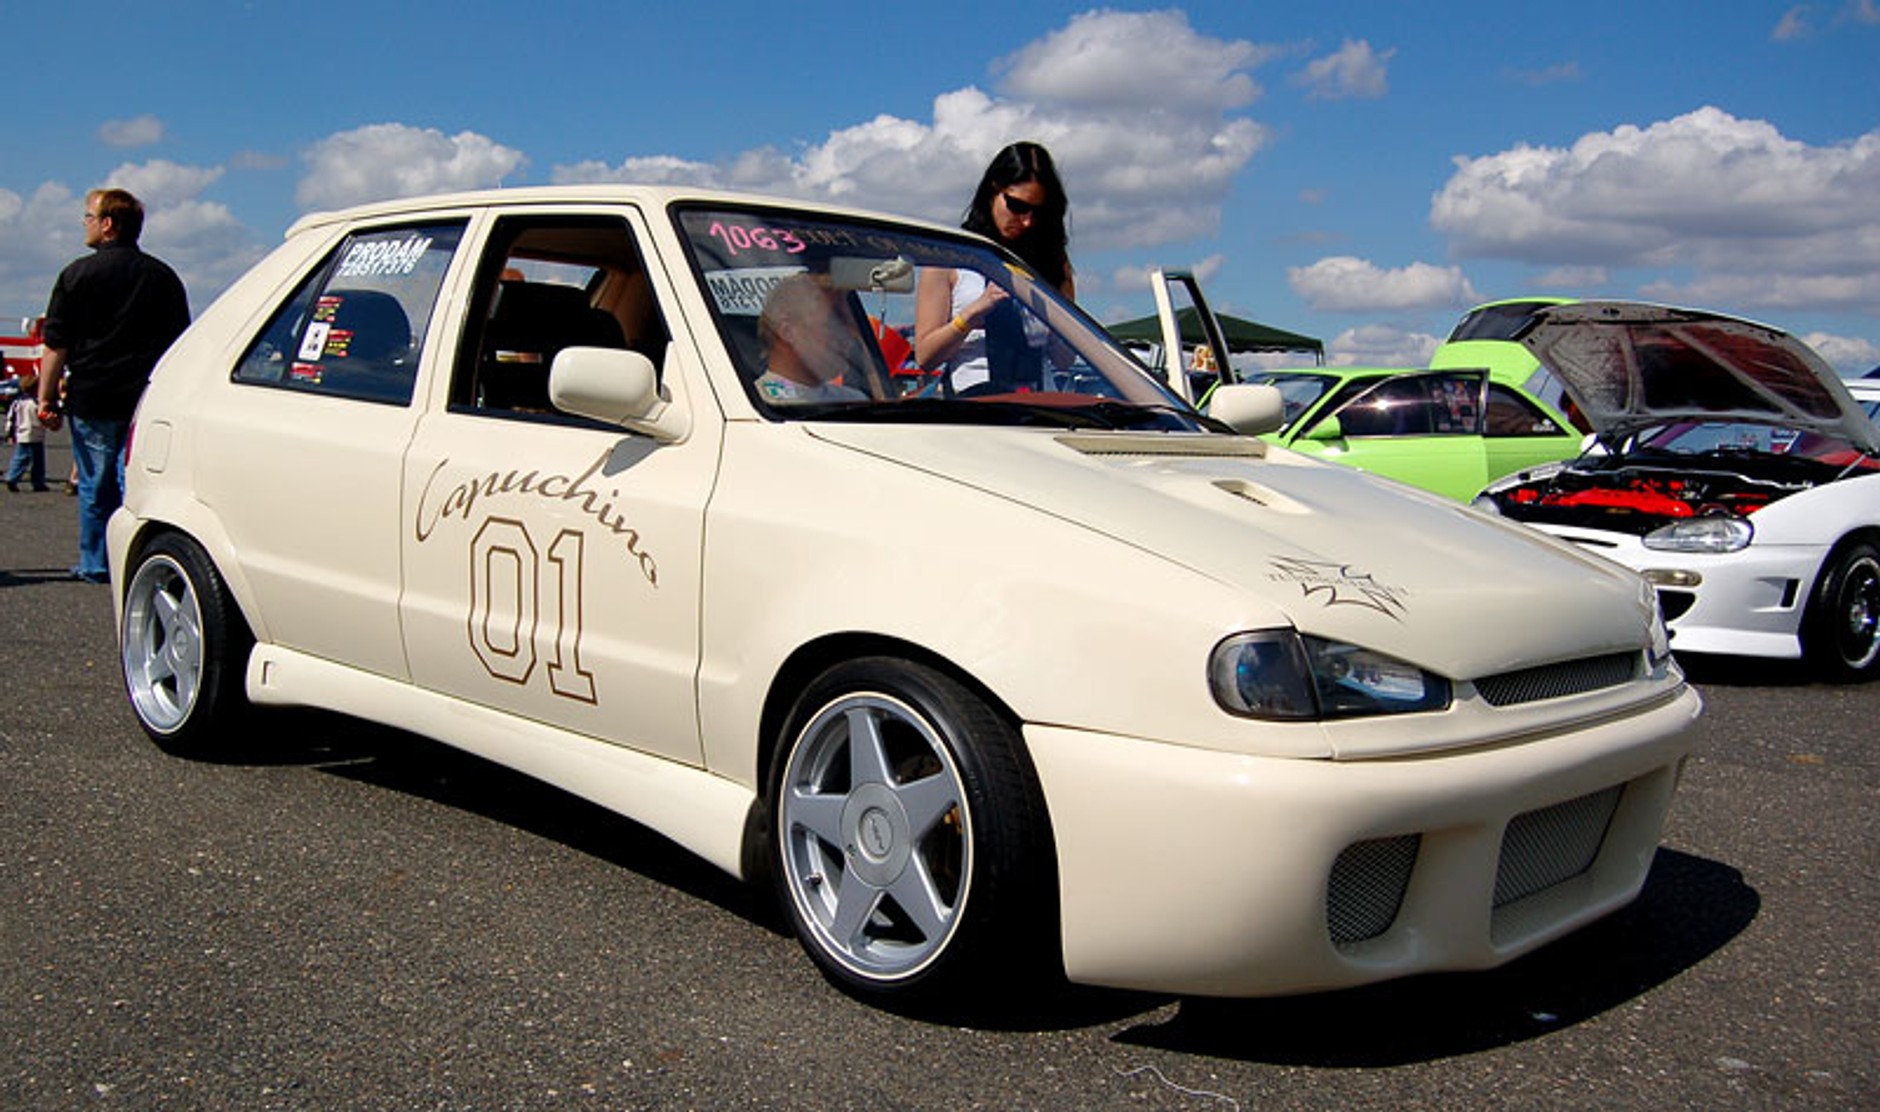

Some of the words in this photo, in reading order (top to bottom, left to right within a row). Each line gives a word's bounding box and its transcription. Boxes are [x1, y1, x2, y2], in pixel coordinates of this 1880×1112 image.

[709, 221, 807, 255] 1063
[416, 447, 659, 590] Capuchino
[467, 515, 599, 706] 01
